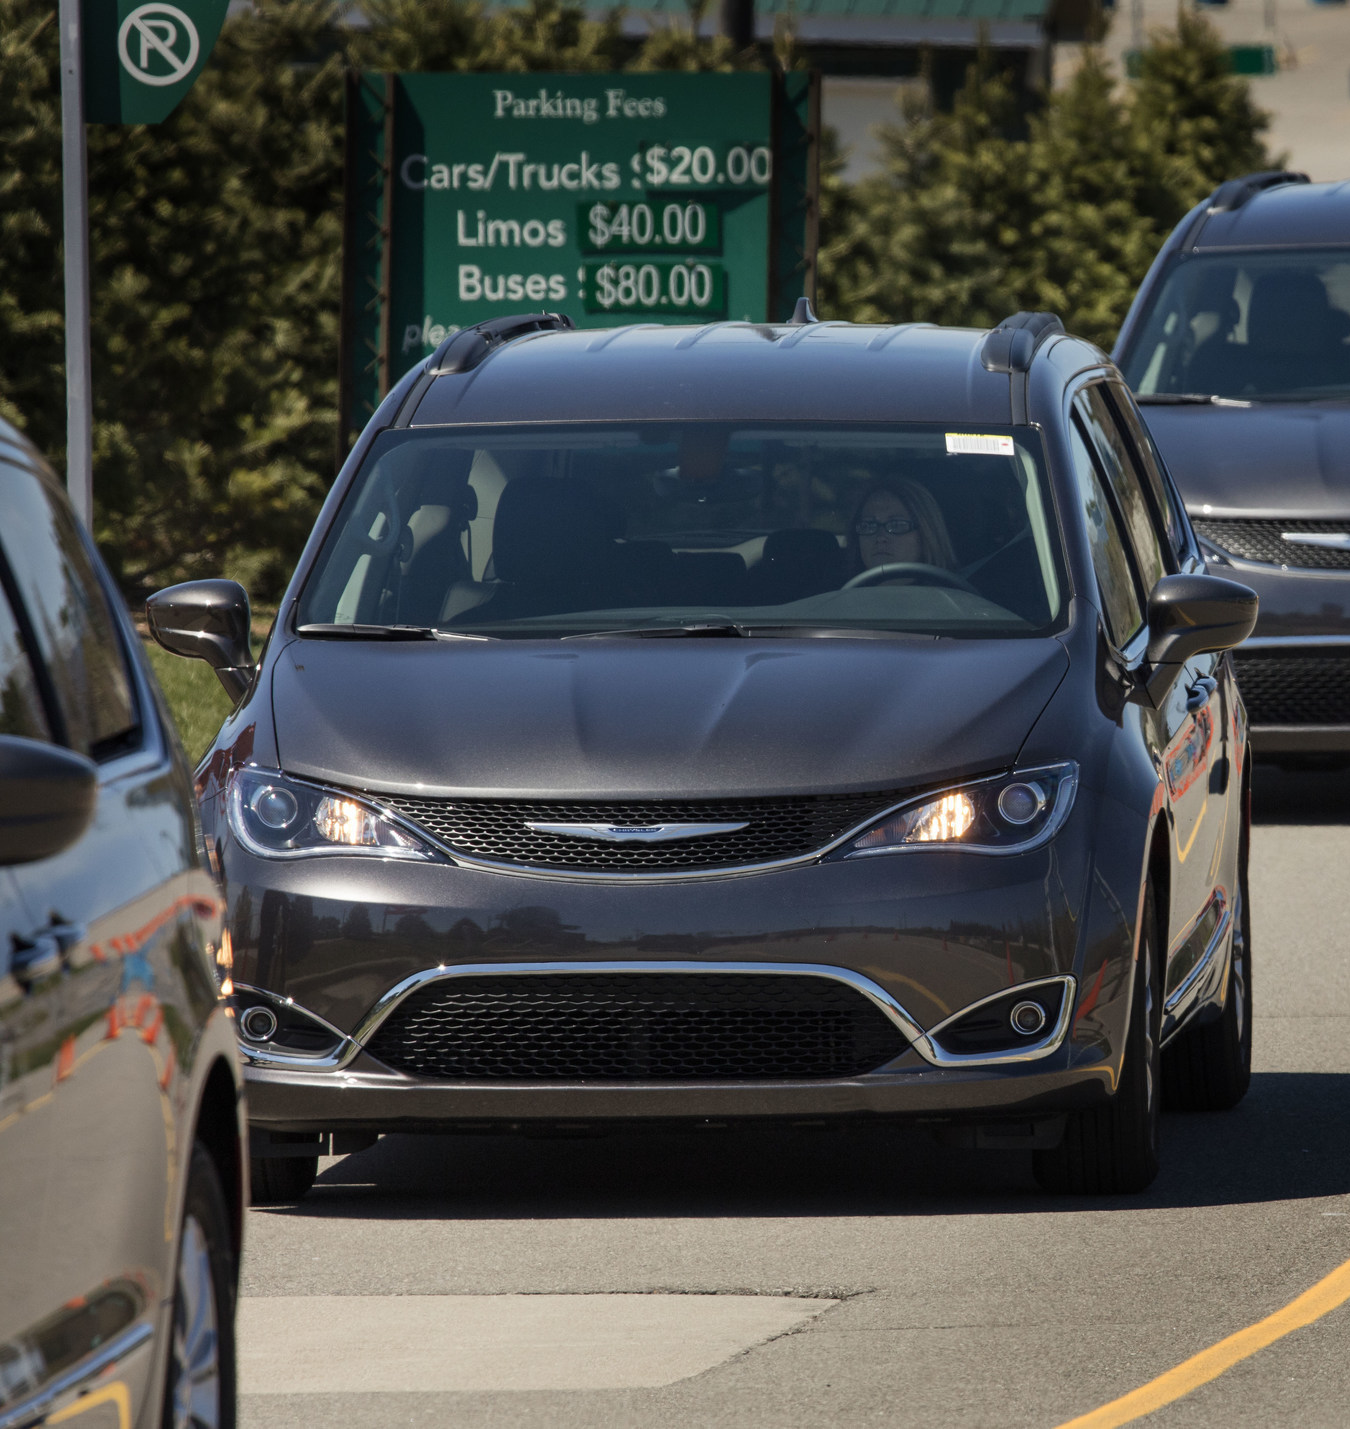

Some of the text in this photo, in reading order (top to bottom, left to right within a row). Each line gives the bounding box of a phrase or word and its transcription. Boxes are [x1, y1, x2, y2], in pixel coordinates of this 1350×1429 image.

[494, 88, 666, 124] Parking Fees
[401, 151, 621, 189] Cars/Trucks
[646, 145, 772, 186] $20.00
[457, 203, 706, 247] Limos $40.00
[458, 264, 567, 300] Buses
[595, 264, 712, 307] $80.00
